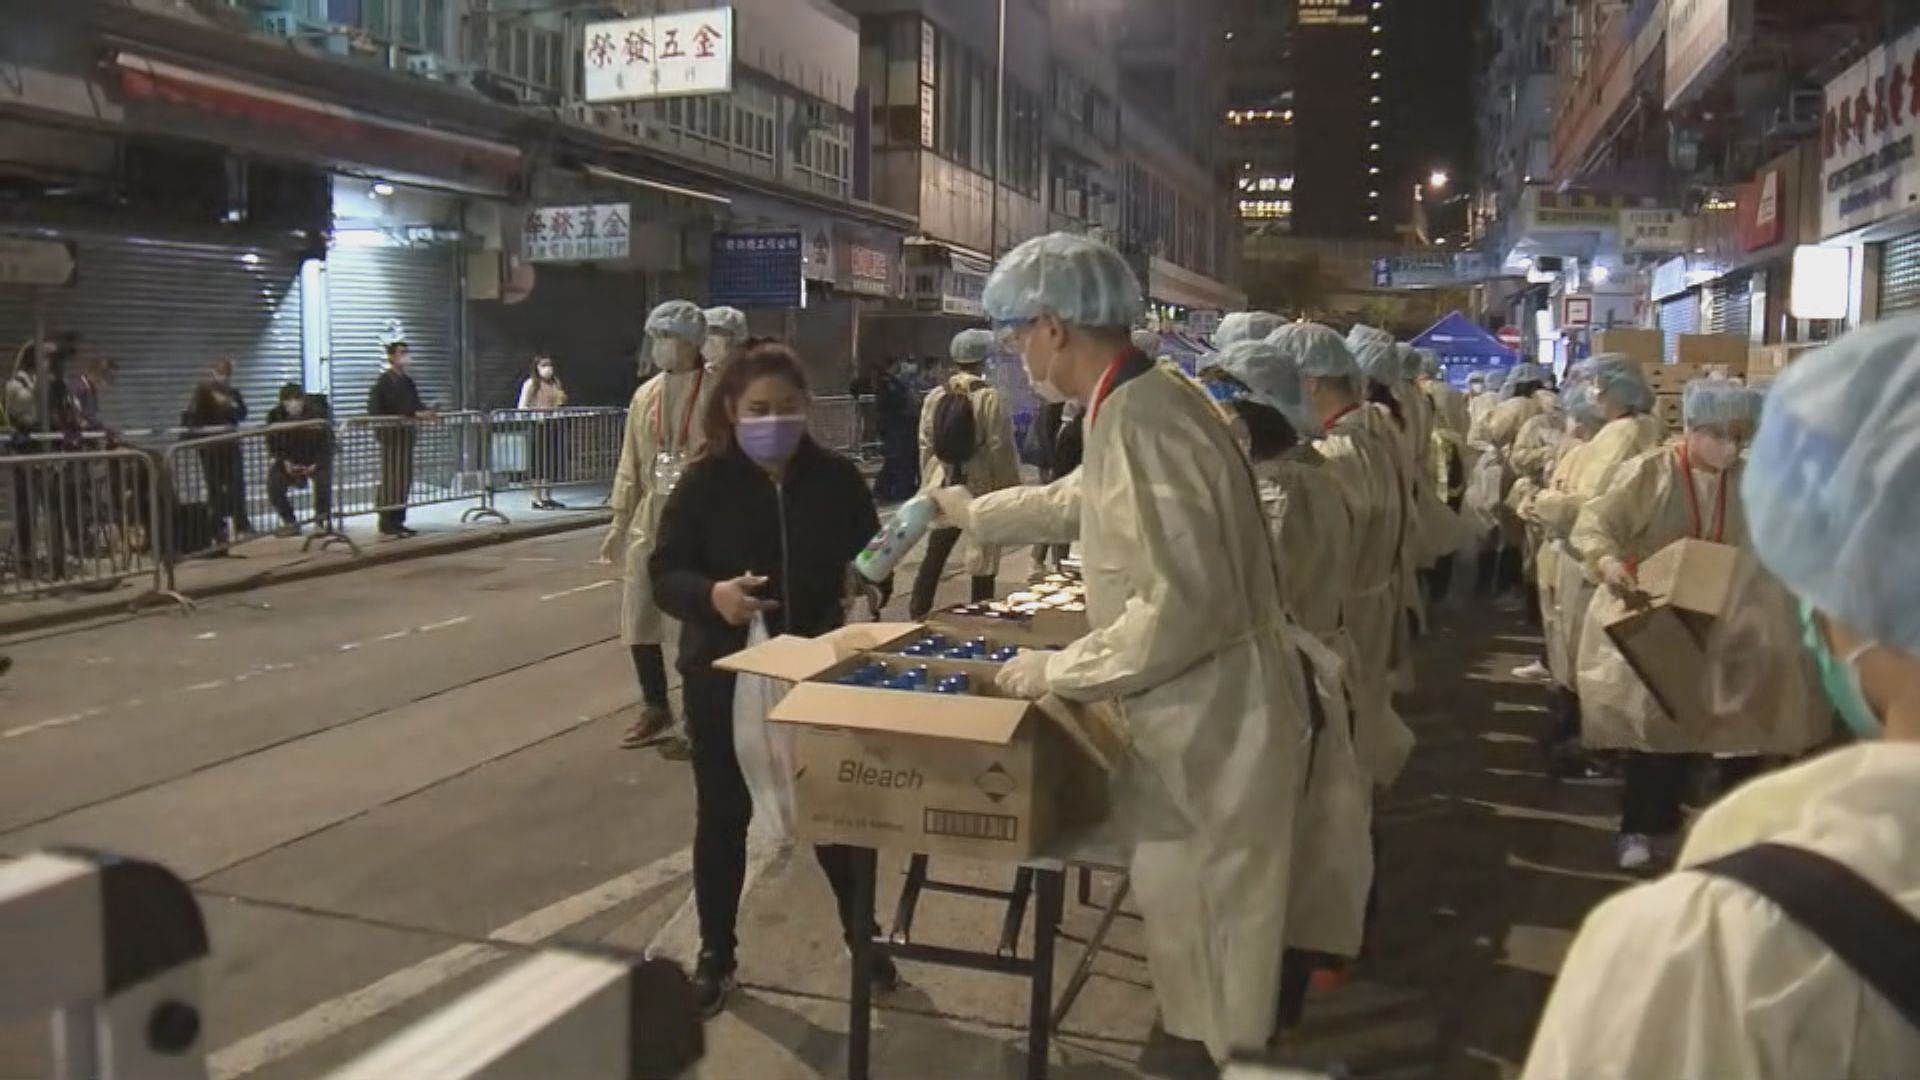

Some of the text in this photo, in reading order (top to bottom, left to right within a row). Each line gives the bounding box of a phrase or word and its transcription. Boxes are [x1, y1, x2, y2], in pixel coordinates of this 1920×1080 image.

[588, 25, 722, 68] 榮發五金
[525, 209, 627, 241] 榮發五金
[837, 759, 923, 791] Bleach
